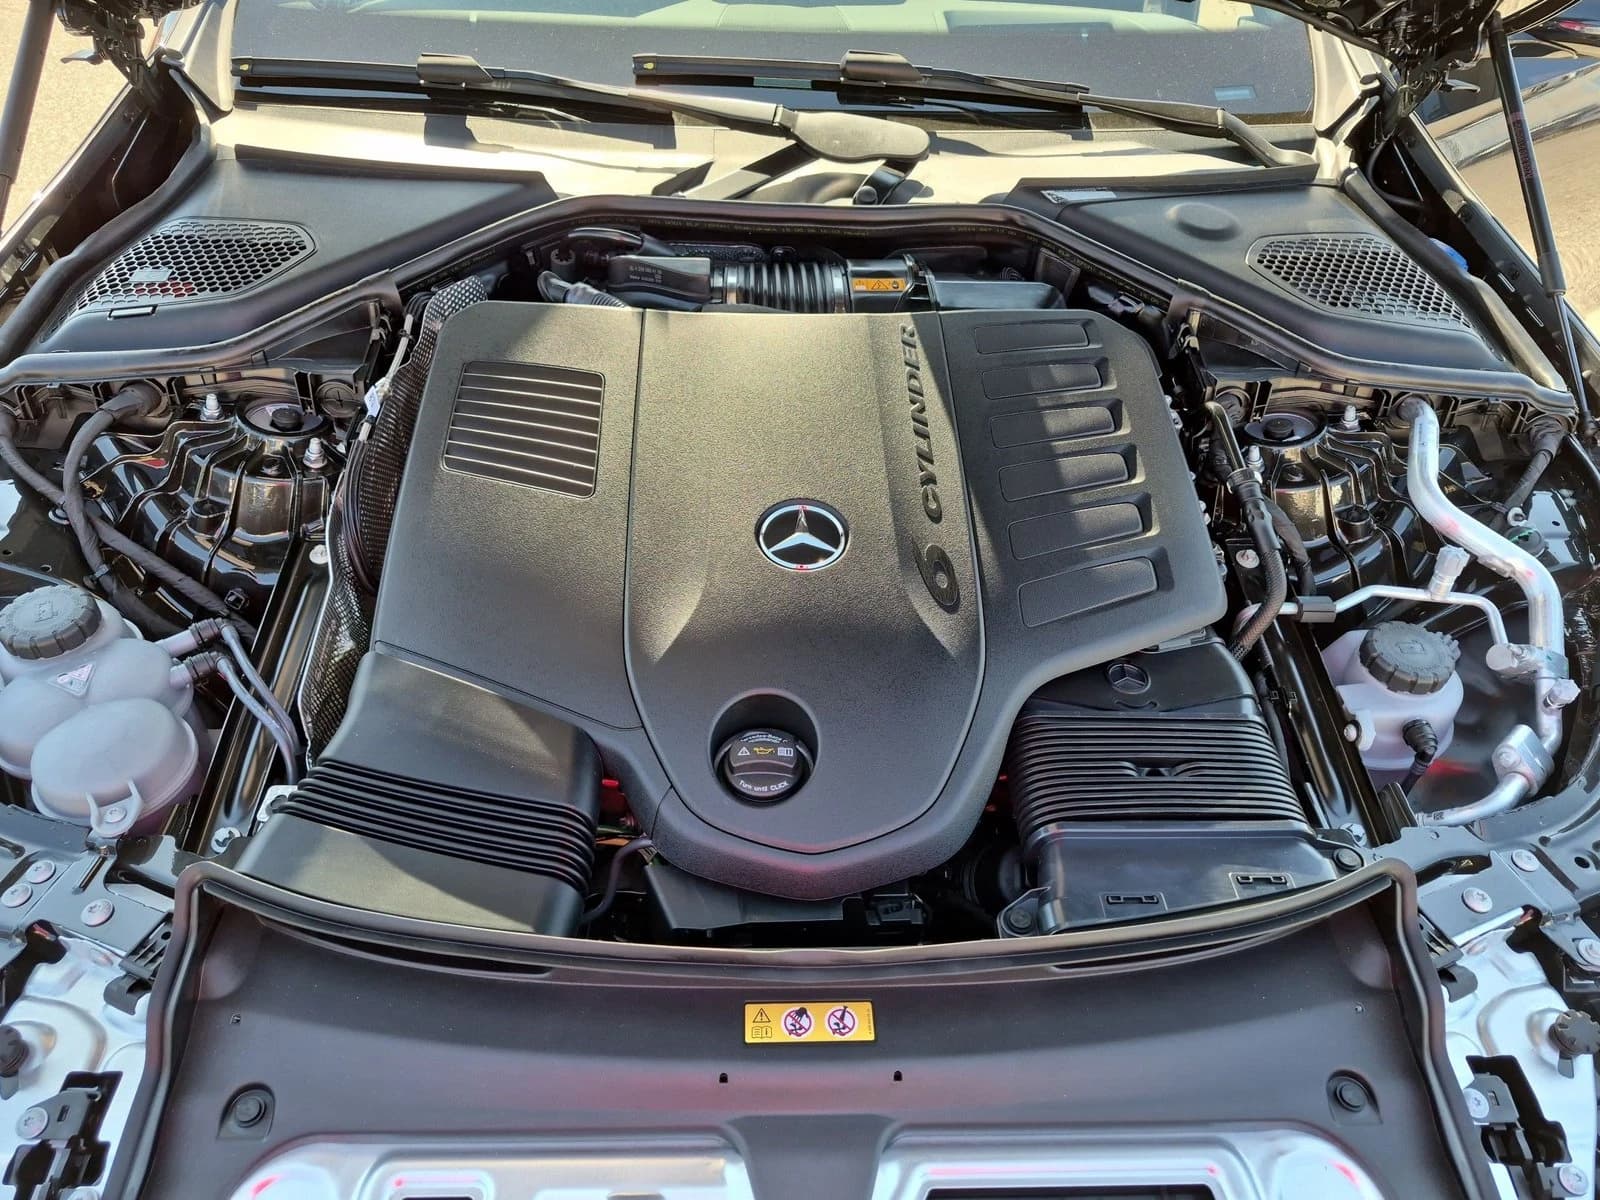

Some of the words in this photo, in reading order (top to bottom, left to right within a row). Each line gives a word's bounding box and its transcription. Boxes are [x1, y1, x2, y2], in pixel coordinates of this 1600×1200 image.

[900, 323, 942, 524] CYLINDER
[912, 536, 960, 613] 6
[770, 781, 788, 791] CLICK
